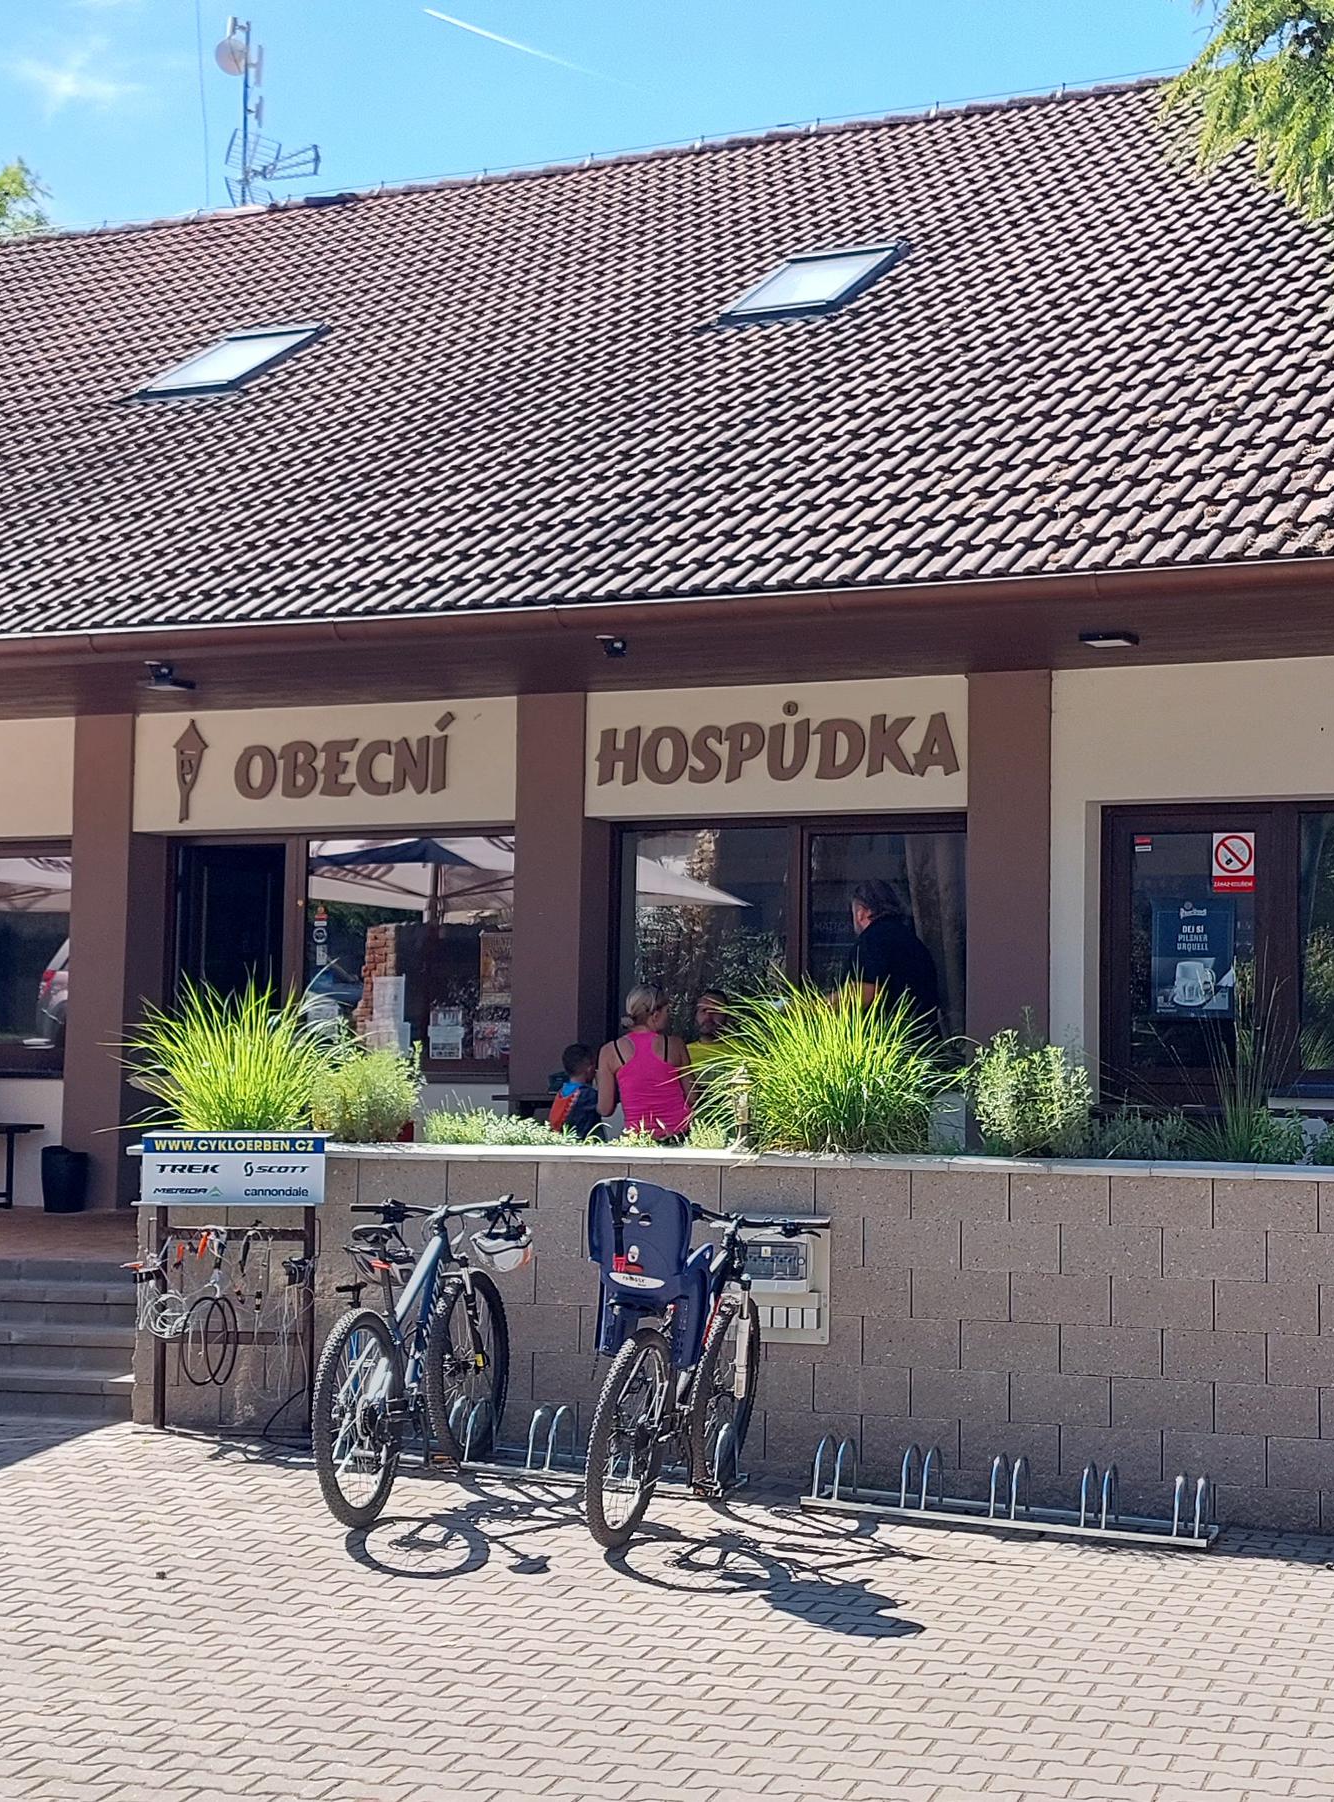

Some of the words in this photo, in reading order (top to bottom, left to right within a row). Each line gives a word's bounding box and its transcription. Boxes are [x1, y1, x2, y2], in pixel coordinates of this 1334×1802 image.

[595, 701, 960, 786] HOSPŮDKA
[234, 711, 456, 800] OBECNÍ
[1182, 925, 1195, 933] DEJ
[1178, 934, 1208, 942] PILSNER
[1177, 943, 1208, 952] URQUELL
[154, 1140, 314, 1152] WWW.CYKLOERBEN.CZ
[156, 1164, 220, 1174] TREK
[255, 1165, 310, 1174] SCOTT
[244, 1187, 309, 1197] cannondale
